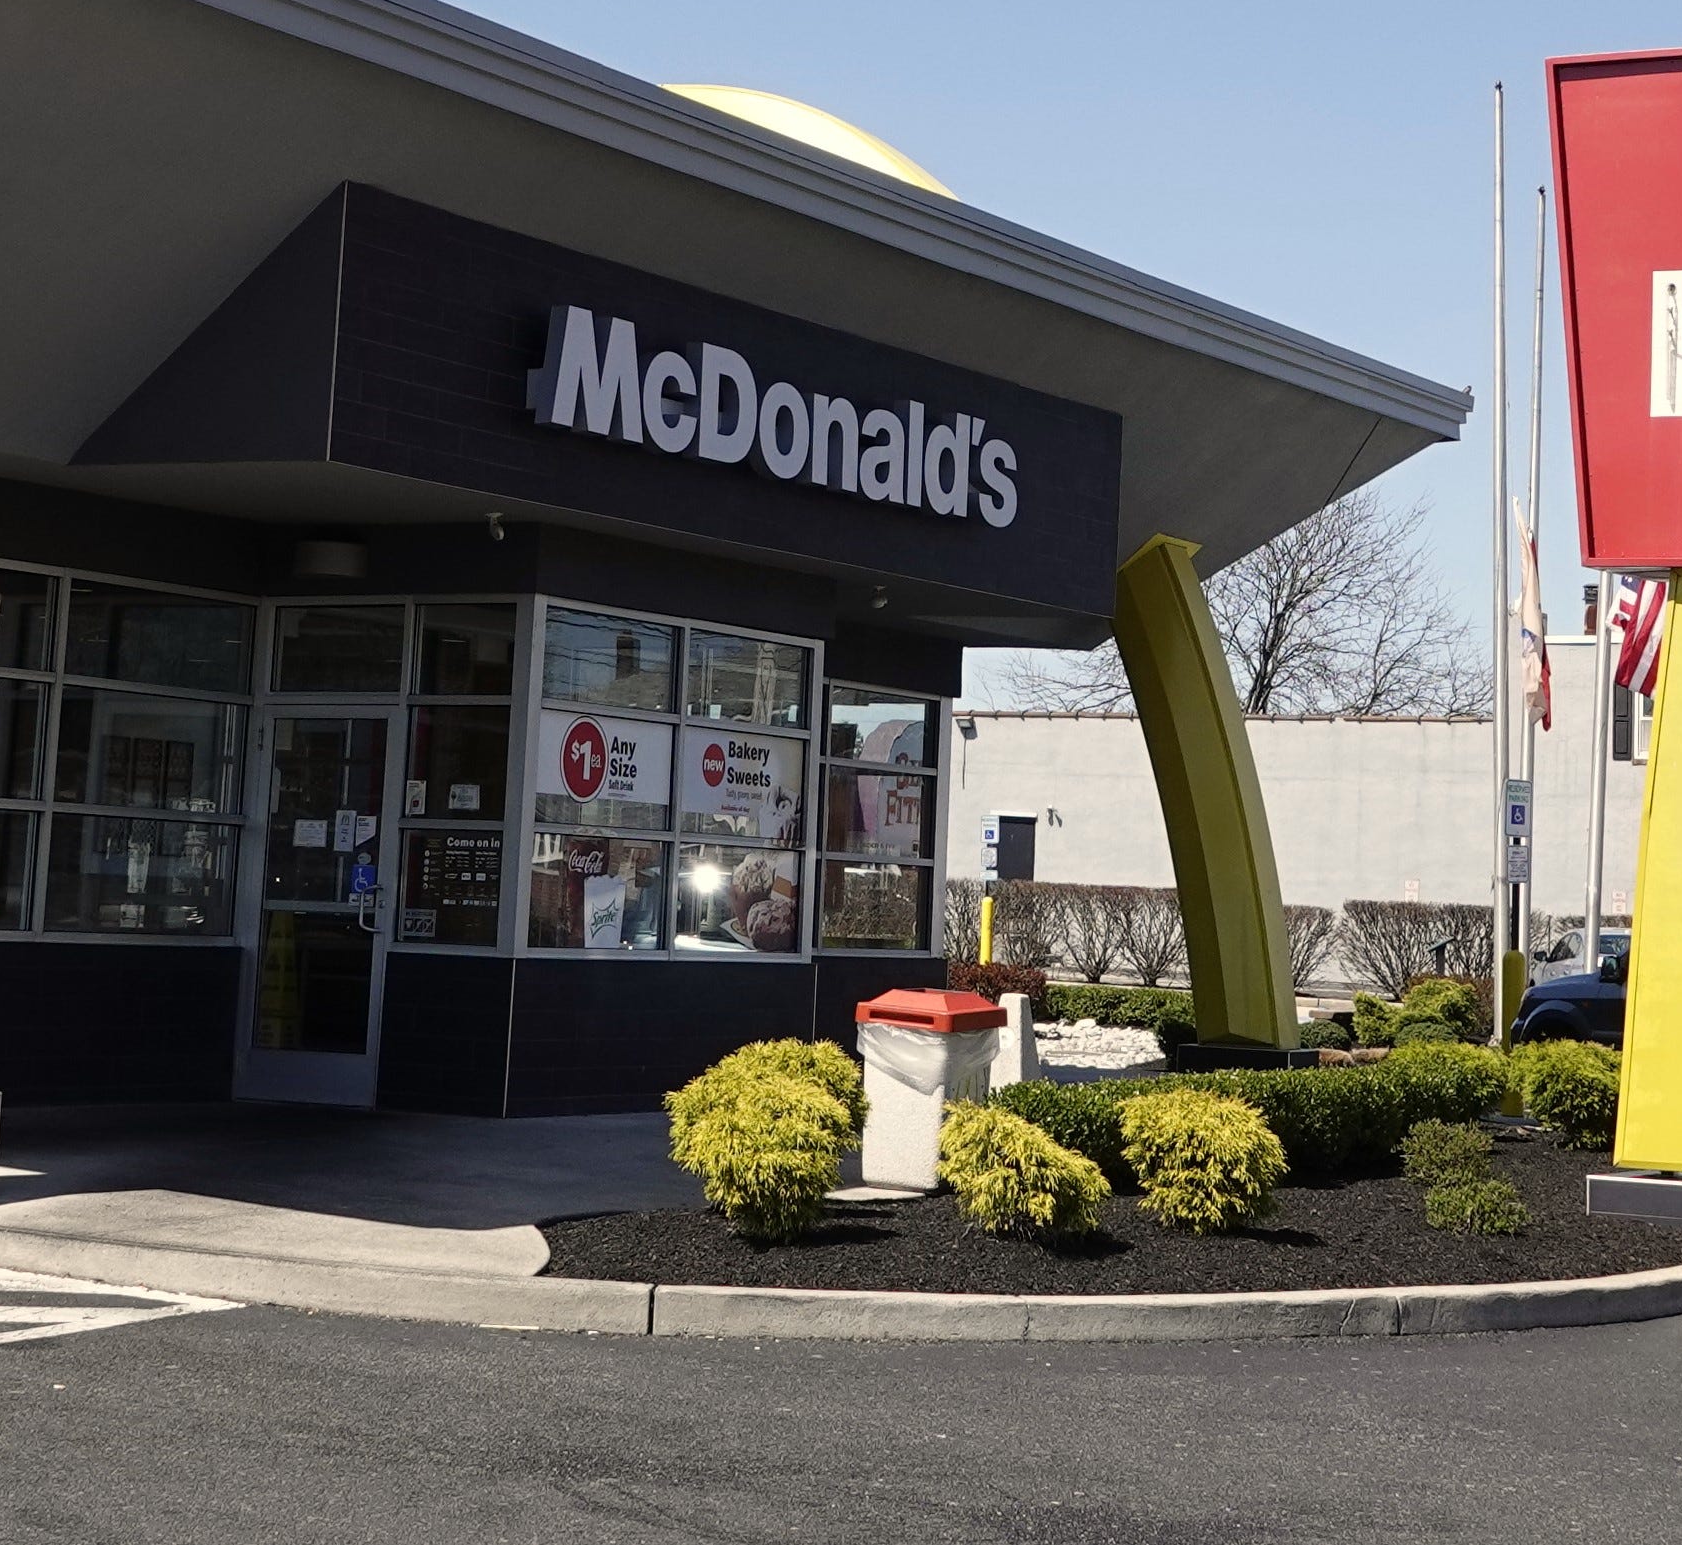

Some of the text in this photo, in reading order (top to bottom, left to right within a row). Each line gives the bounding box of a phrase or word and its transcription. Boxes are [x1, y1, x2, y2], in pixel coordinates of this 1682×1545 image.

[549, 304, 1018, 529] McDonald's
[610, 736, 636, 760] Any
[728, 740, 770, 767] Bakery
[609, 757, 637, 778] Size
[703, 758, 724, 772] new
[726, 766, 771, 788] Sweets
[590, 908, 616, 929] Sprite
